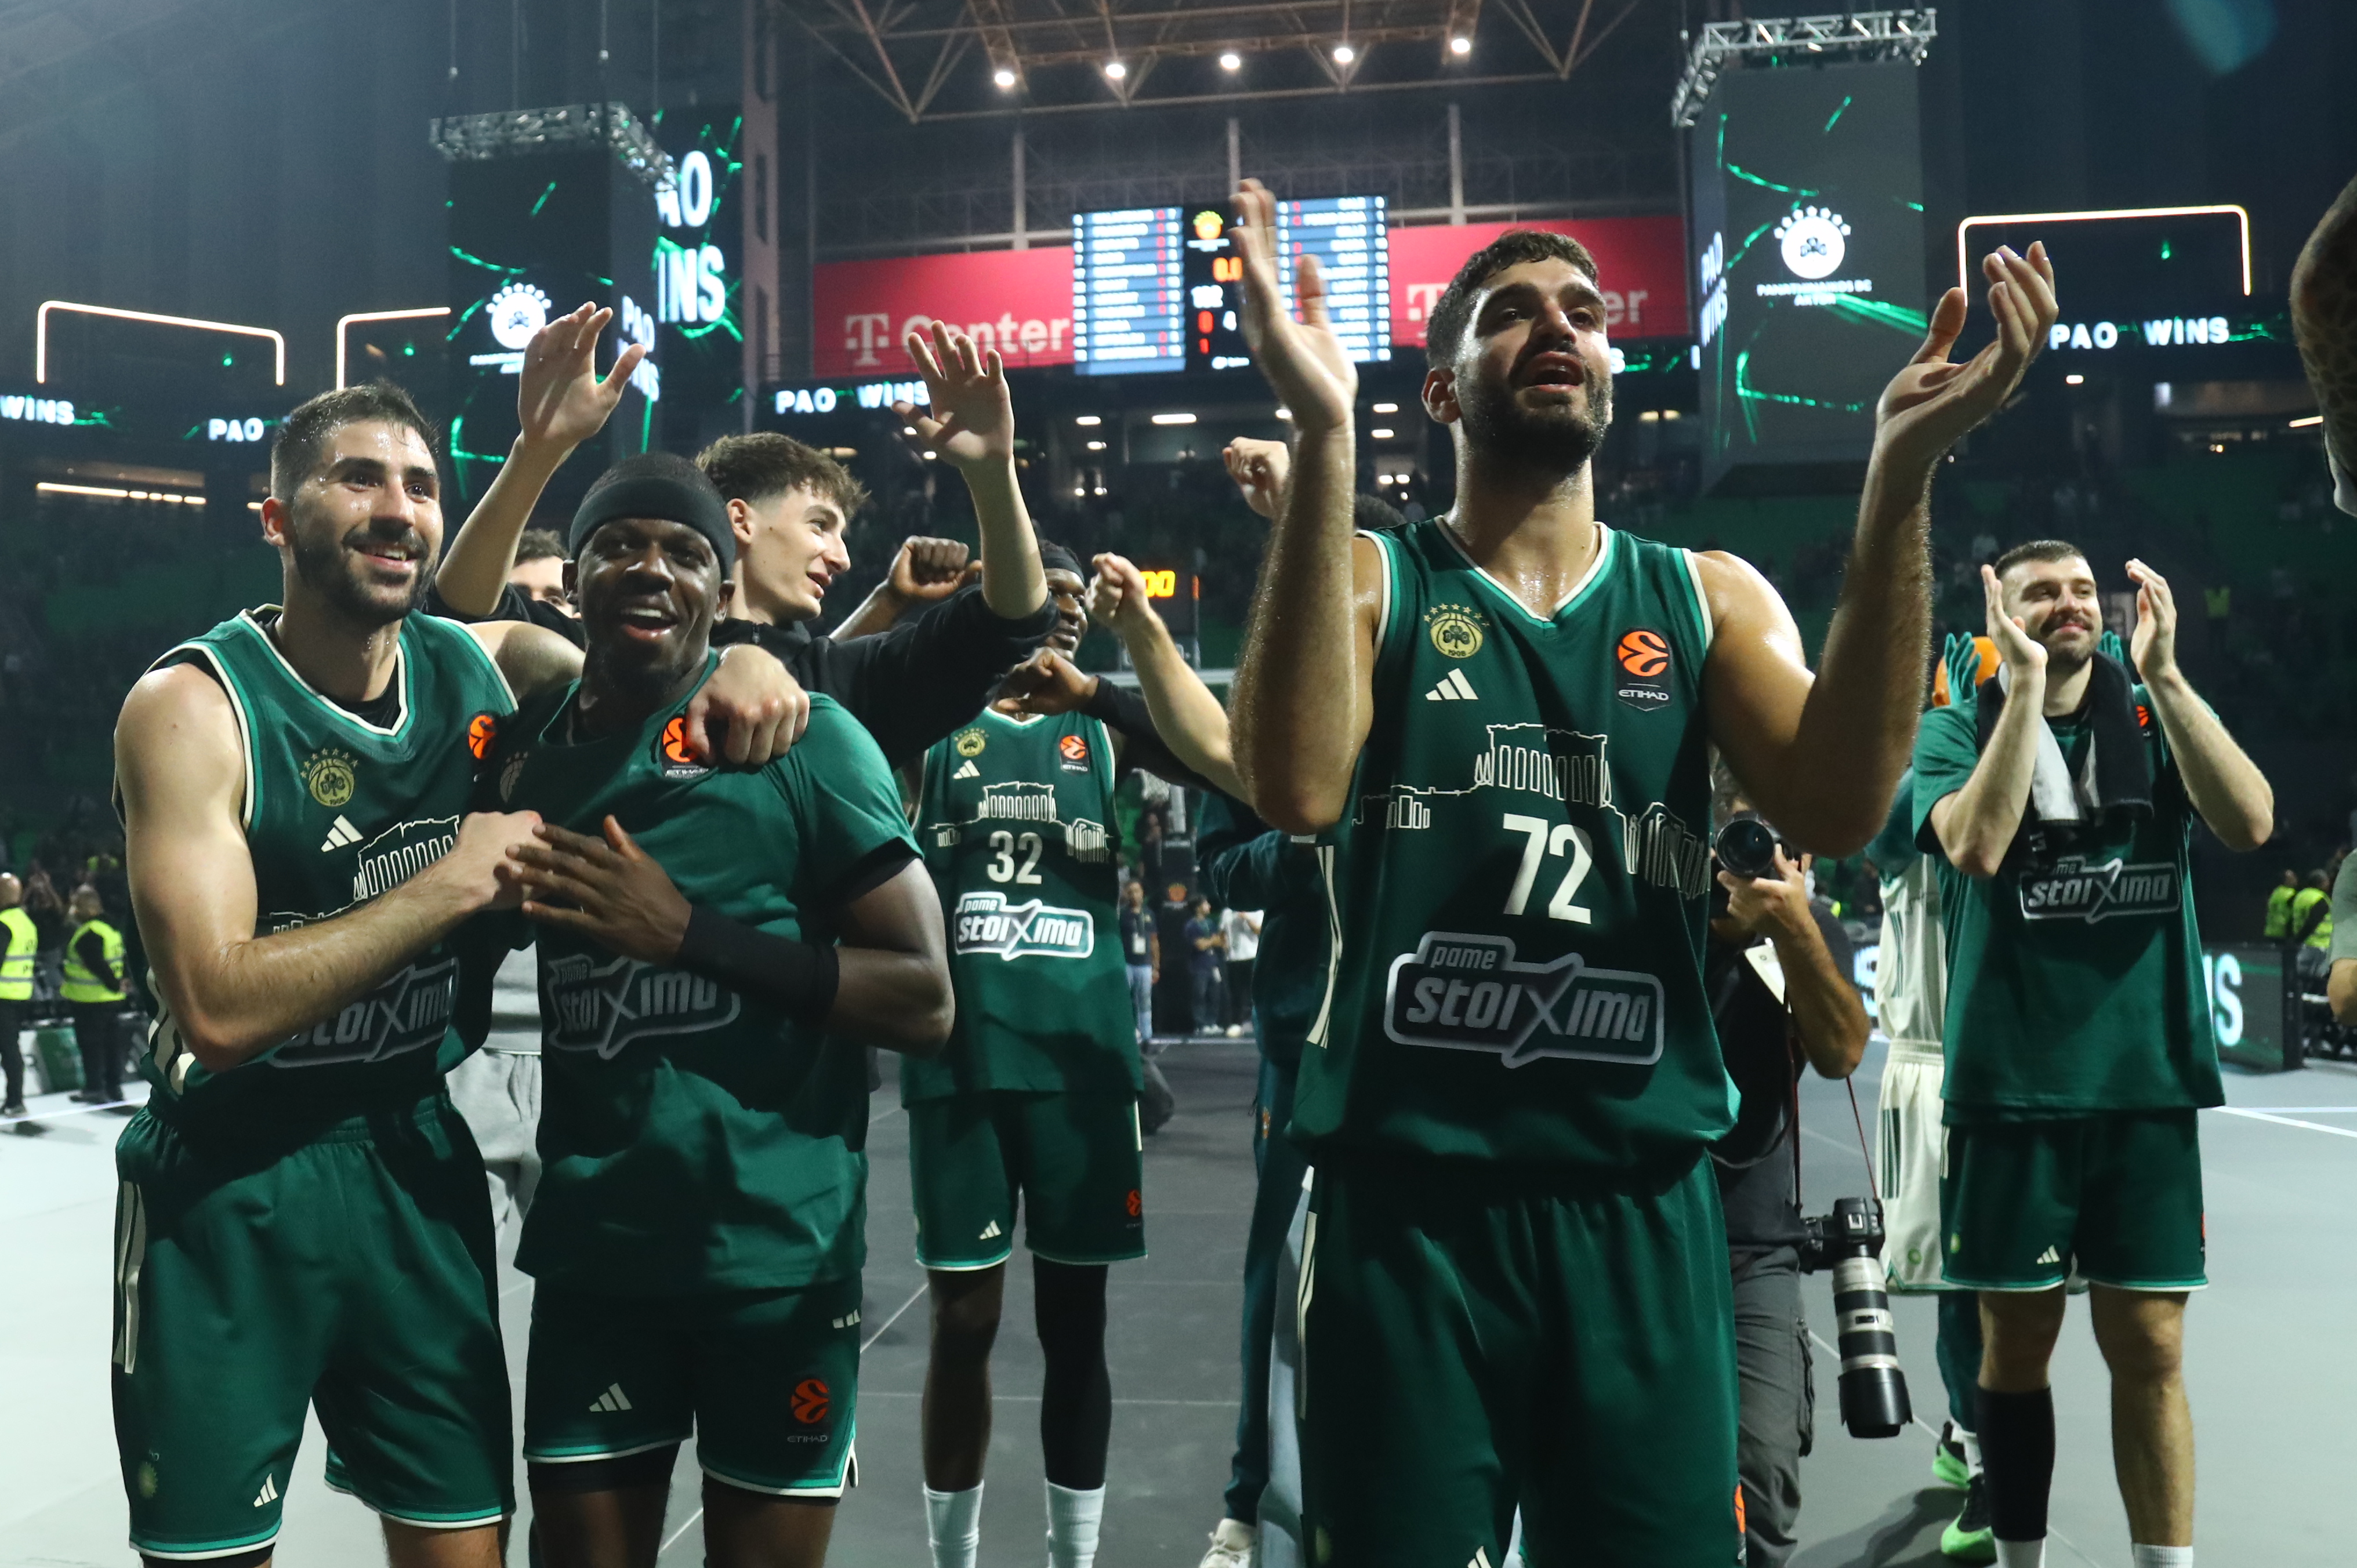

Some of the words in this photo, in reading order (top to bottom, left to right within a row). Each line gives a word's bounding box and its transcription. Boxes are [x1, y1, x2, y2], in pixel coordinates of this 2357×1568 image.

[658, 245, 725, 323] INS
[622, 296, 655, 353] PAO
[2050, 322, 2117, 349] PAO
[2144, 317, 2229, 346] WINS
[0, 395, 75, 425] WINS
[776, 387, 836, 413] PAO
[857, 380, 930, 409] WINS
[209, 418, 264, 442] PAO
[1619, 689, 1669, 700] ETIHAD
[987, 831, 1043, 884] 32
[1503, 813, 1593, 924] 72
[964, 899, 998, 913] pame
[1430, 946, 1497, 970] pame
[787, 1435, 828, 1443] ETIHAD
